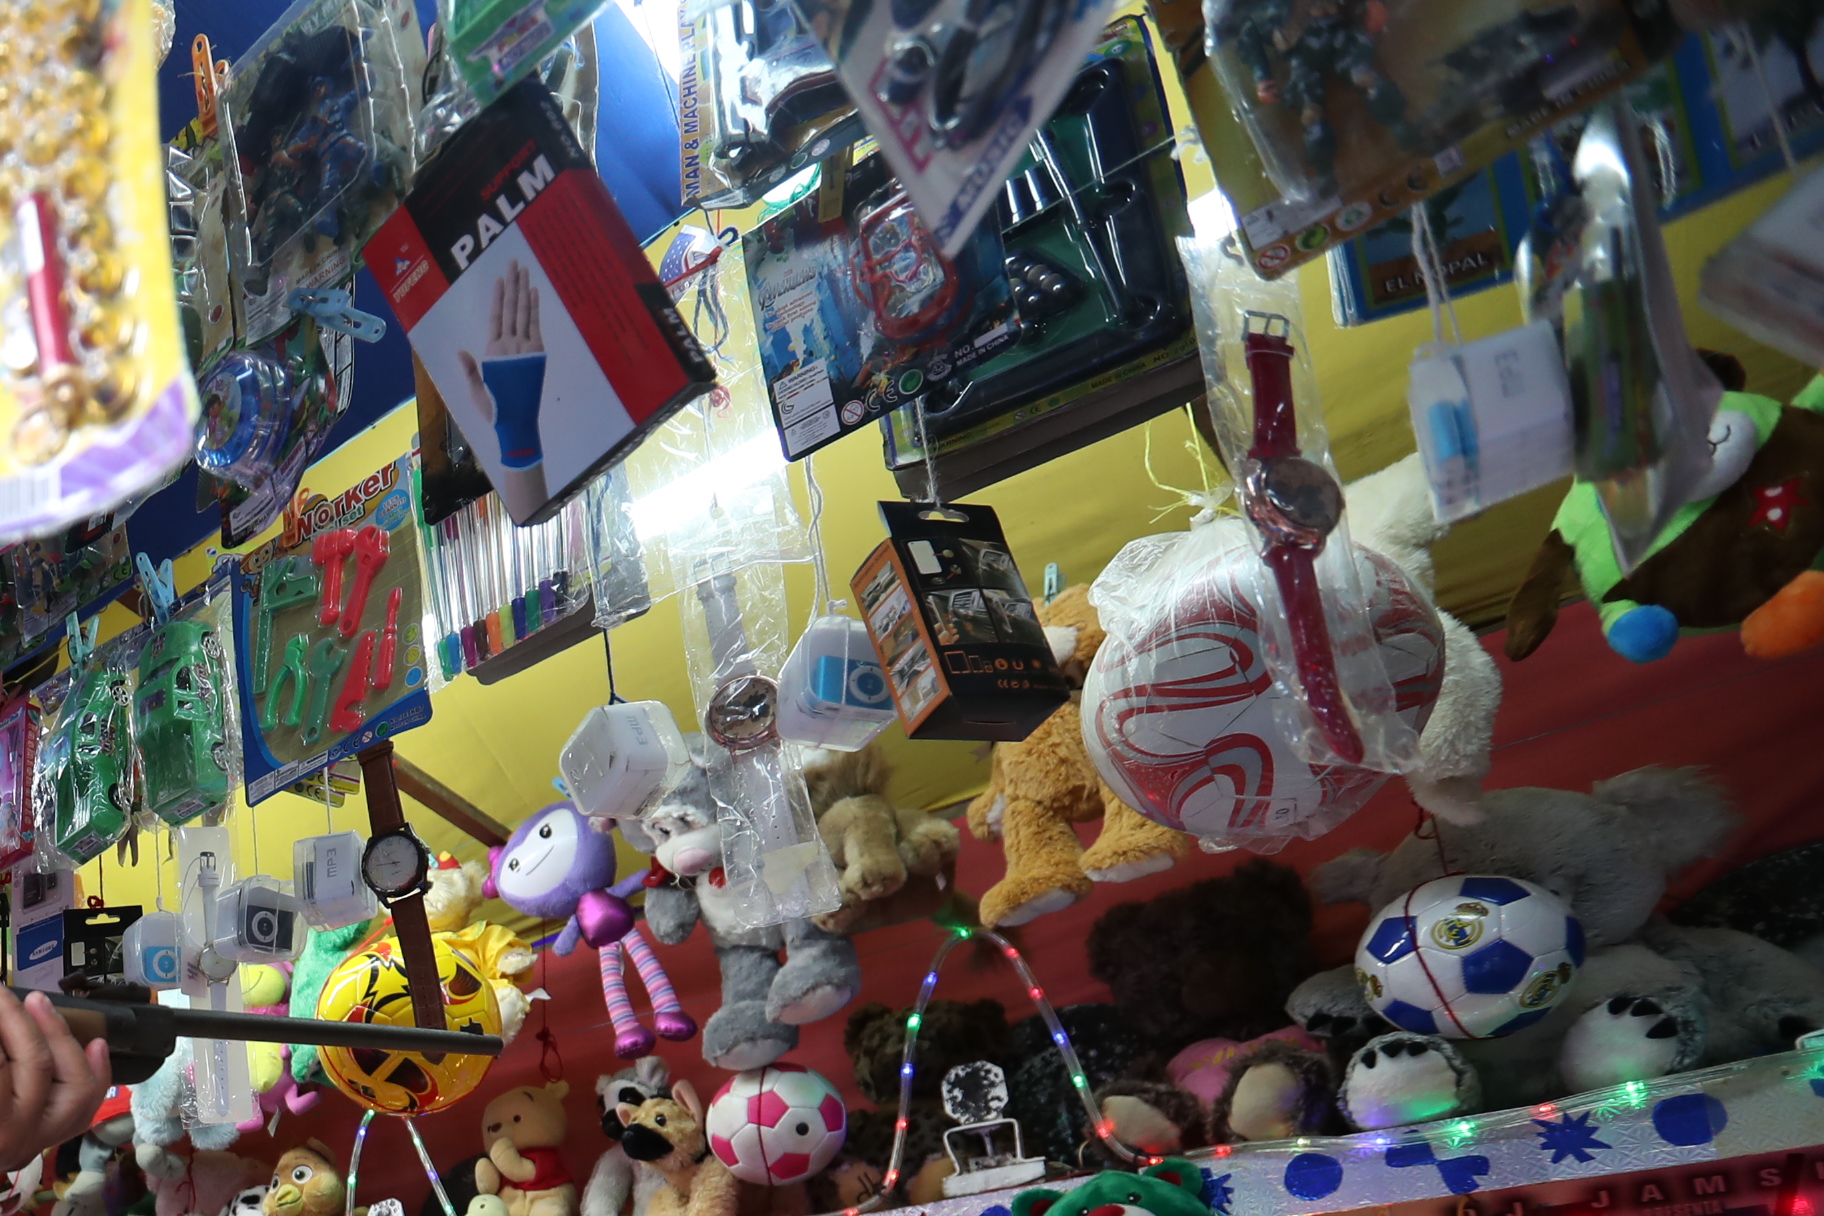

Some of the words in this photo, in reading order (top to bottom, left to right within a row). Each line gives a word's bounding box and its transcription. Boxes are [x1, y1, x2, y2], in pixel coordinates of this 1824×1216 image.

[681, 54, 699, 135] MACHINE
[684, 137, 700, 150] &
[685, 155, 700, 197] MAN
[450, 153, 556, 271] PALM
[1384, 276, 1412, 293] EL
[663, 308, 705, 364] PALM
[956, 353, 978, 367] MADE
[978, 348, 986, 359] IN
[986, 334, 1010, 353] CHINA
[341, 506, 365, 526] set
